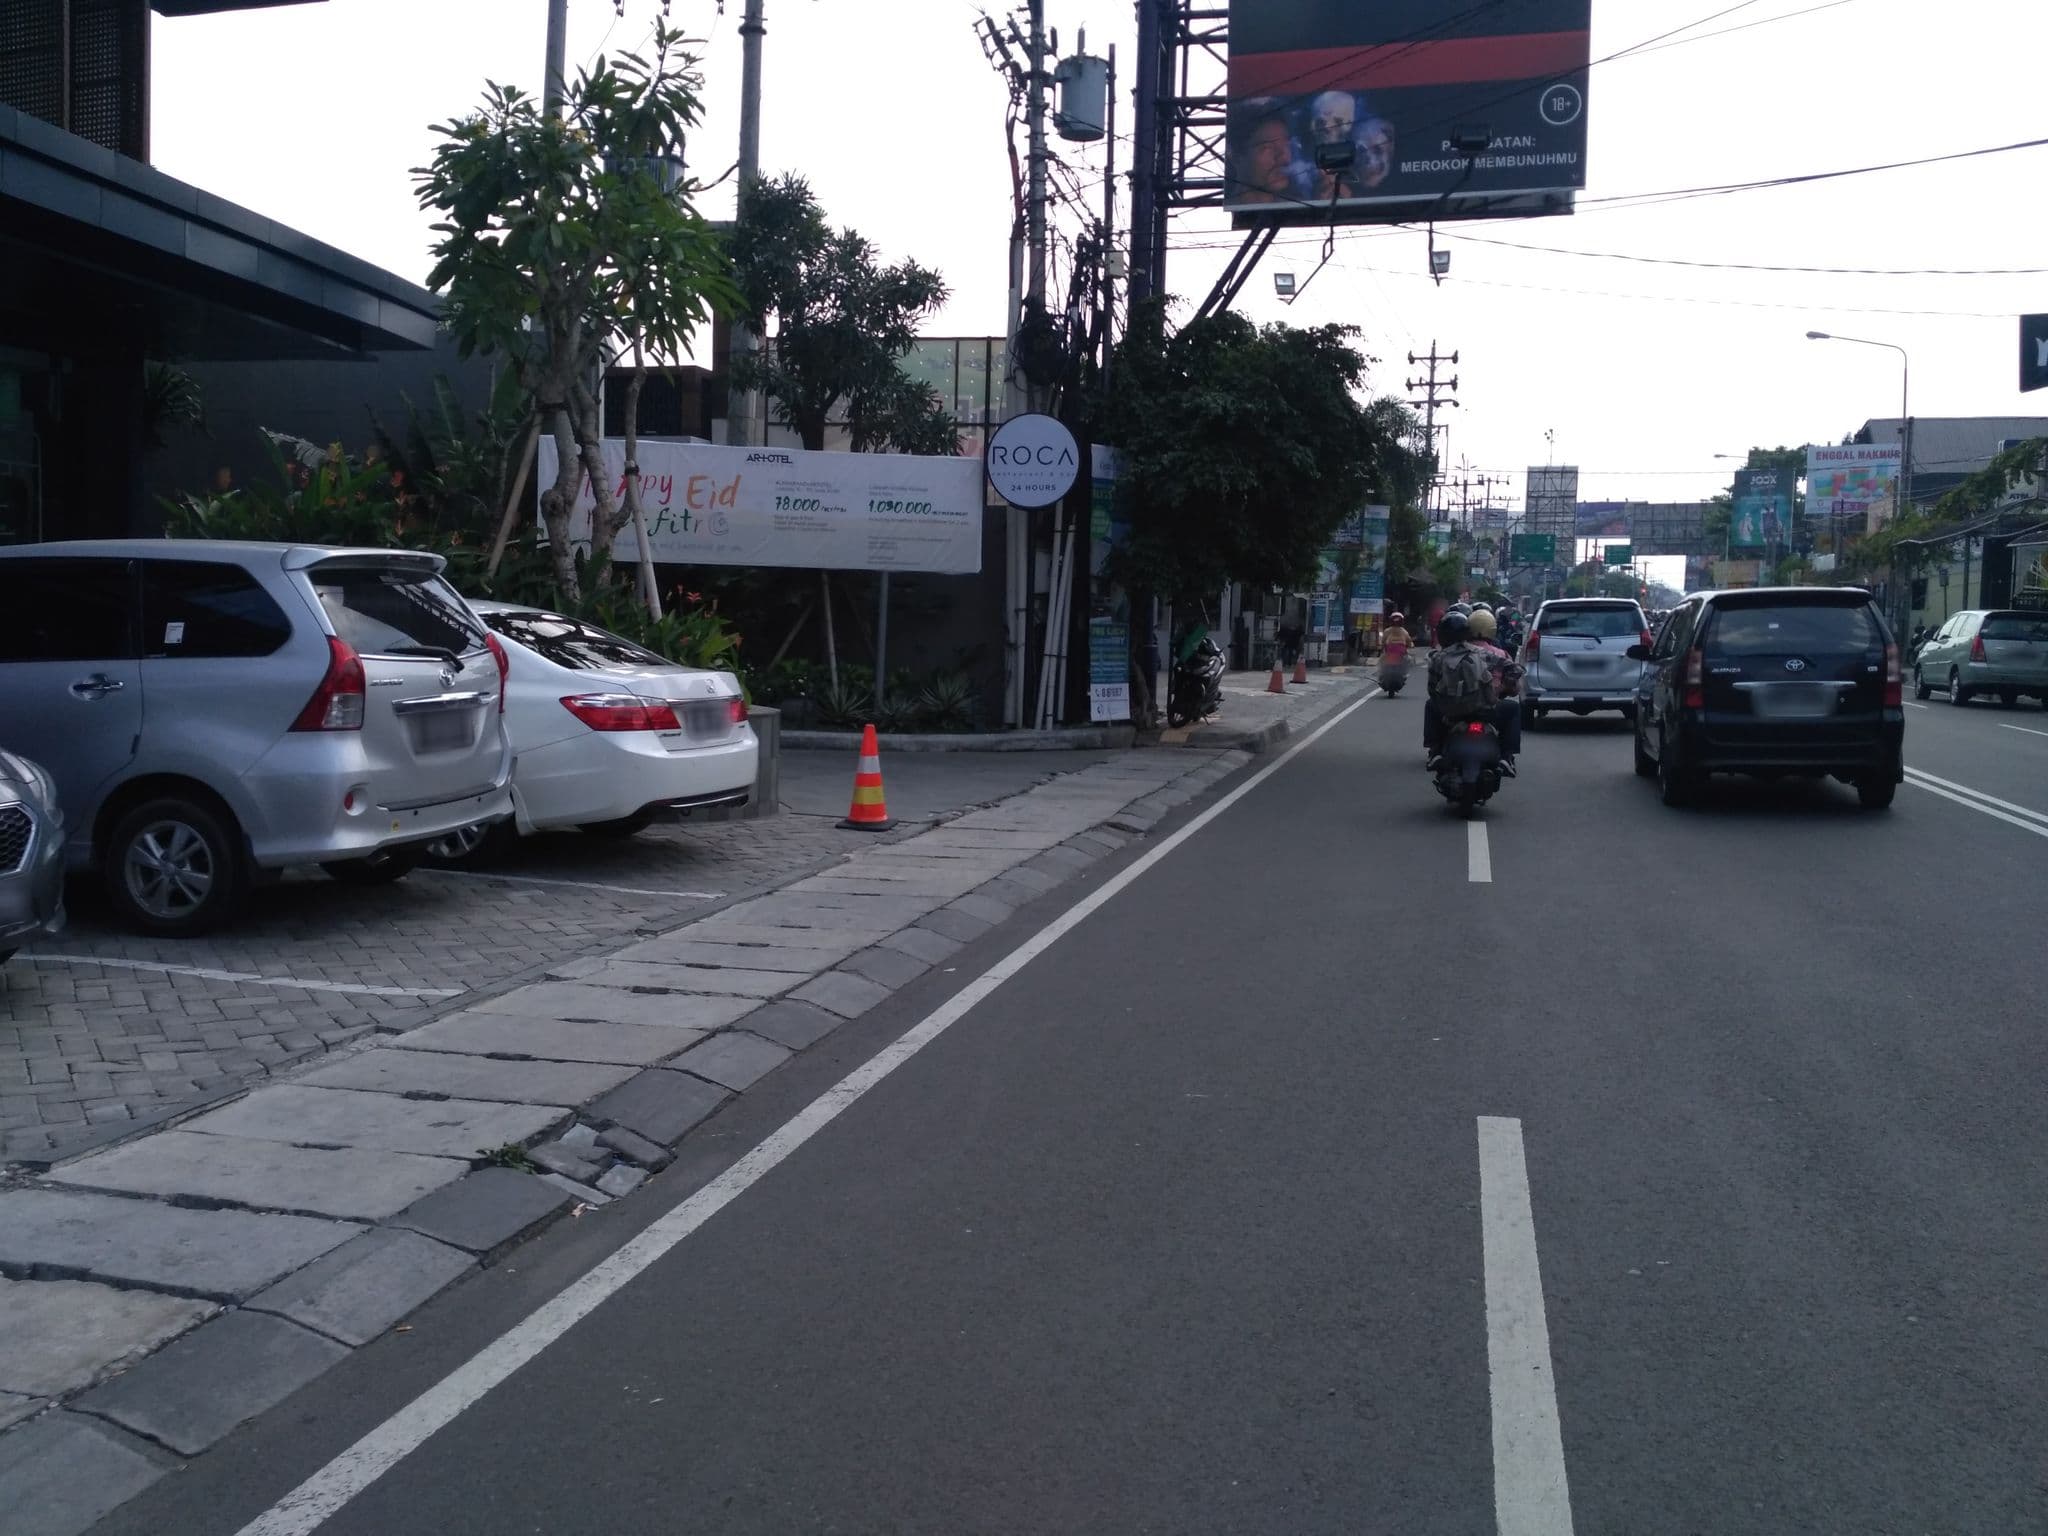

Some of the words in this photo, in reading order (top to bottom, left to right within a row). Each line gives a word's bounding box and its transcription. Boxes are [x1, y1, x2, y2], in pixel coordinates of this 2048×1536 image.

[1551, 96, 1573, 112] 18+
[1401, 158, 1470, 173] MEROKOK
[1474, 153, 1578, 169] MEMBUNUHMU
[992, 445, 1075, 466] ROCA
[1857, 447, 1902, 461] MAKMUR
[686, 473, 743, 509] Eid
[1011, 484, 1022, 492] 24
[1025, 483, 1057, 492] HOURS
[775, 495, 821, 511] 78.000
